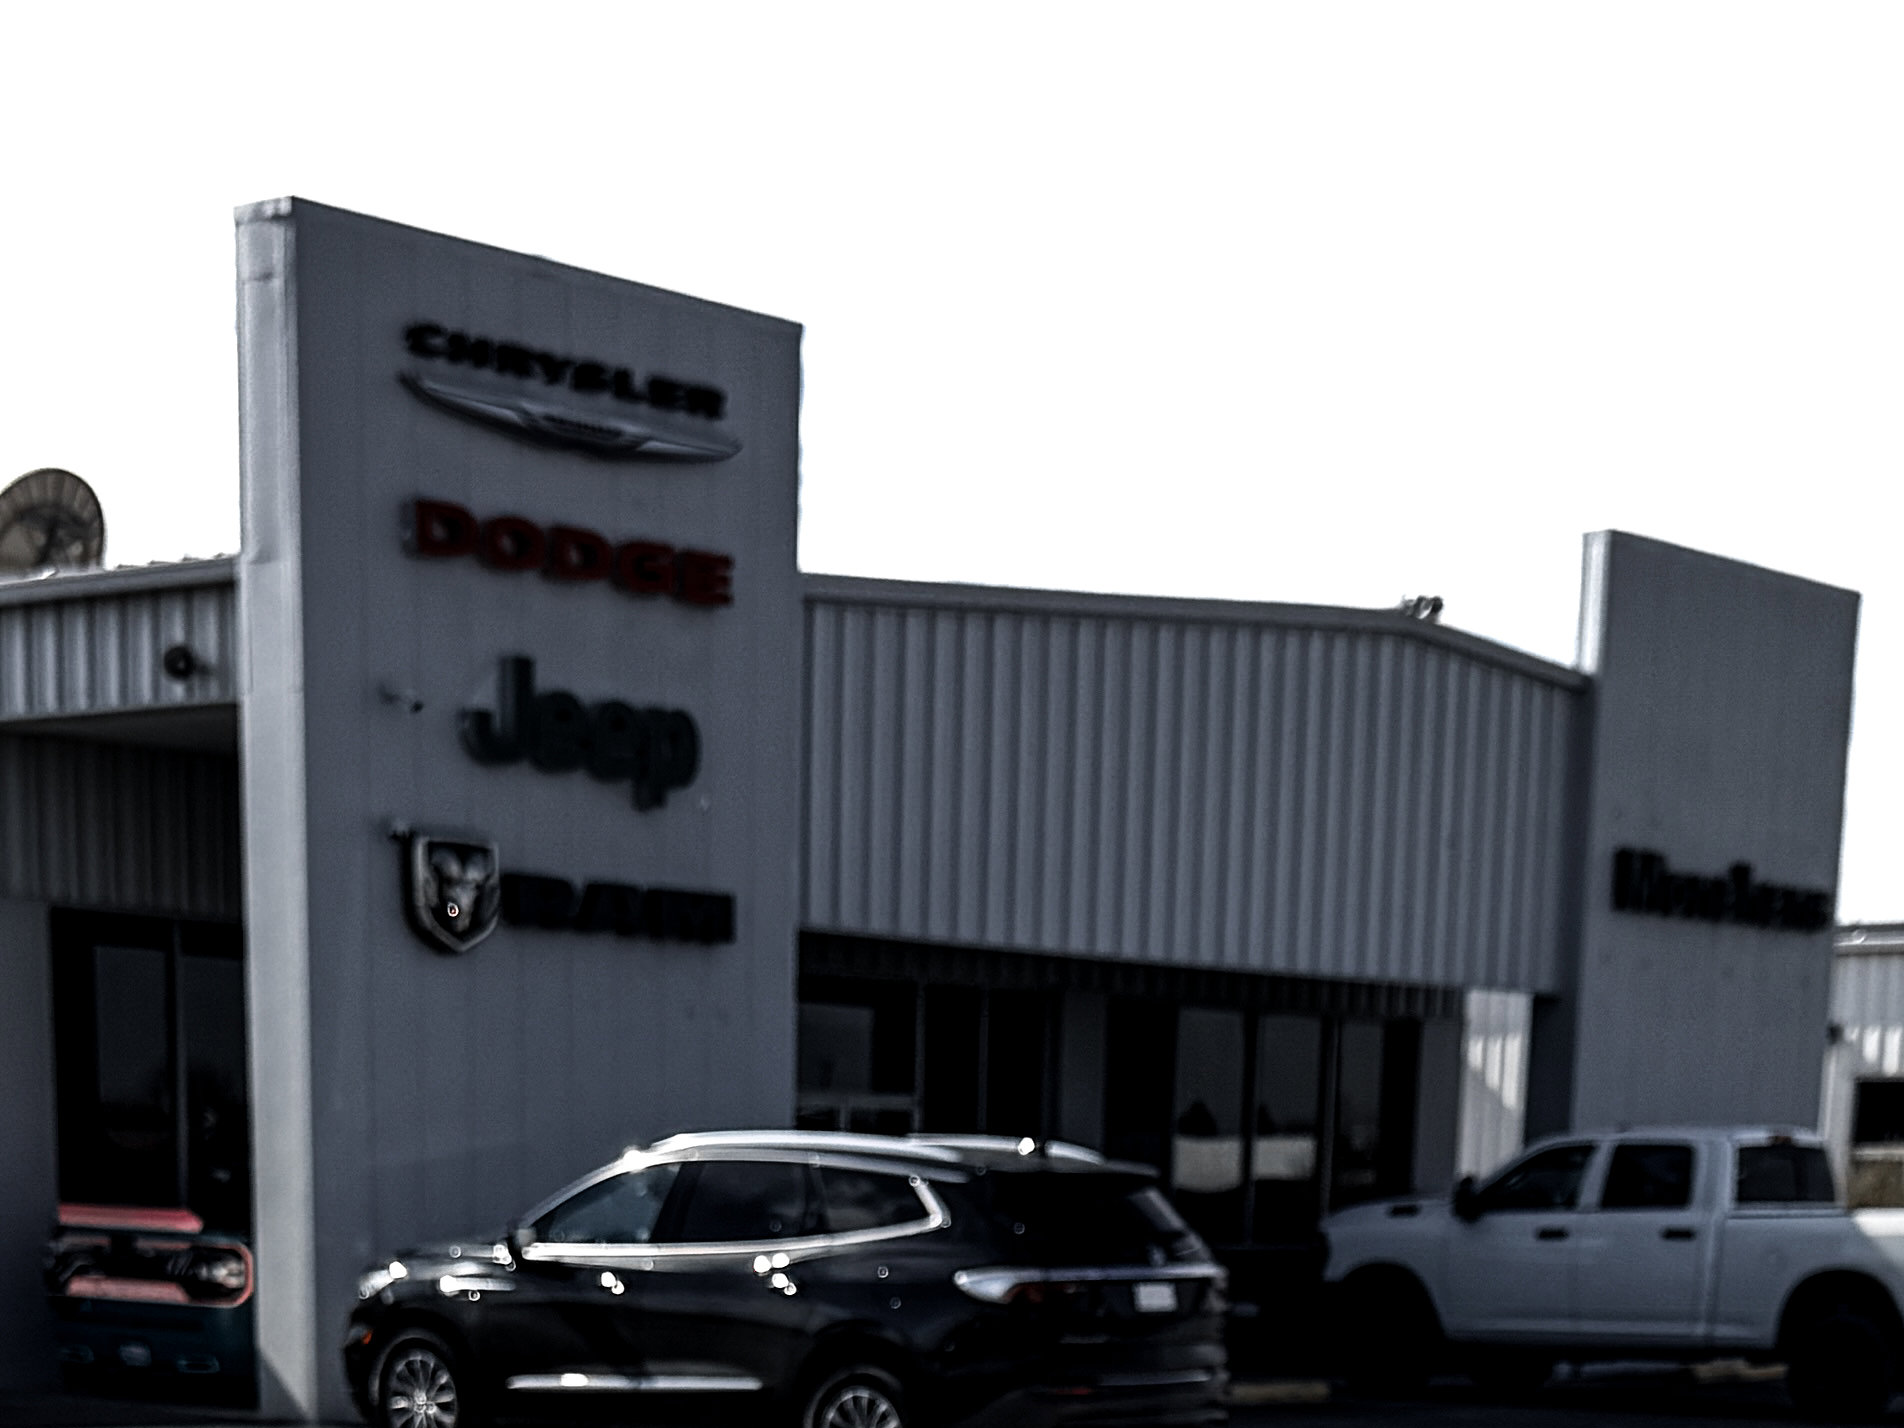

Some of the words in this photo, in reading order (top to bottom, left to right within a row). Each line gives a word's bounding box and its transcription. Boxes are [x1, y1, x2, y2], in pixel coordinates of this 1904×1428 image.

[405, 322, 726, 419] CHRYSLER
[408, 497, 736, 608] DODGE
[462, 654, 700, 810] Jeep
